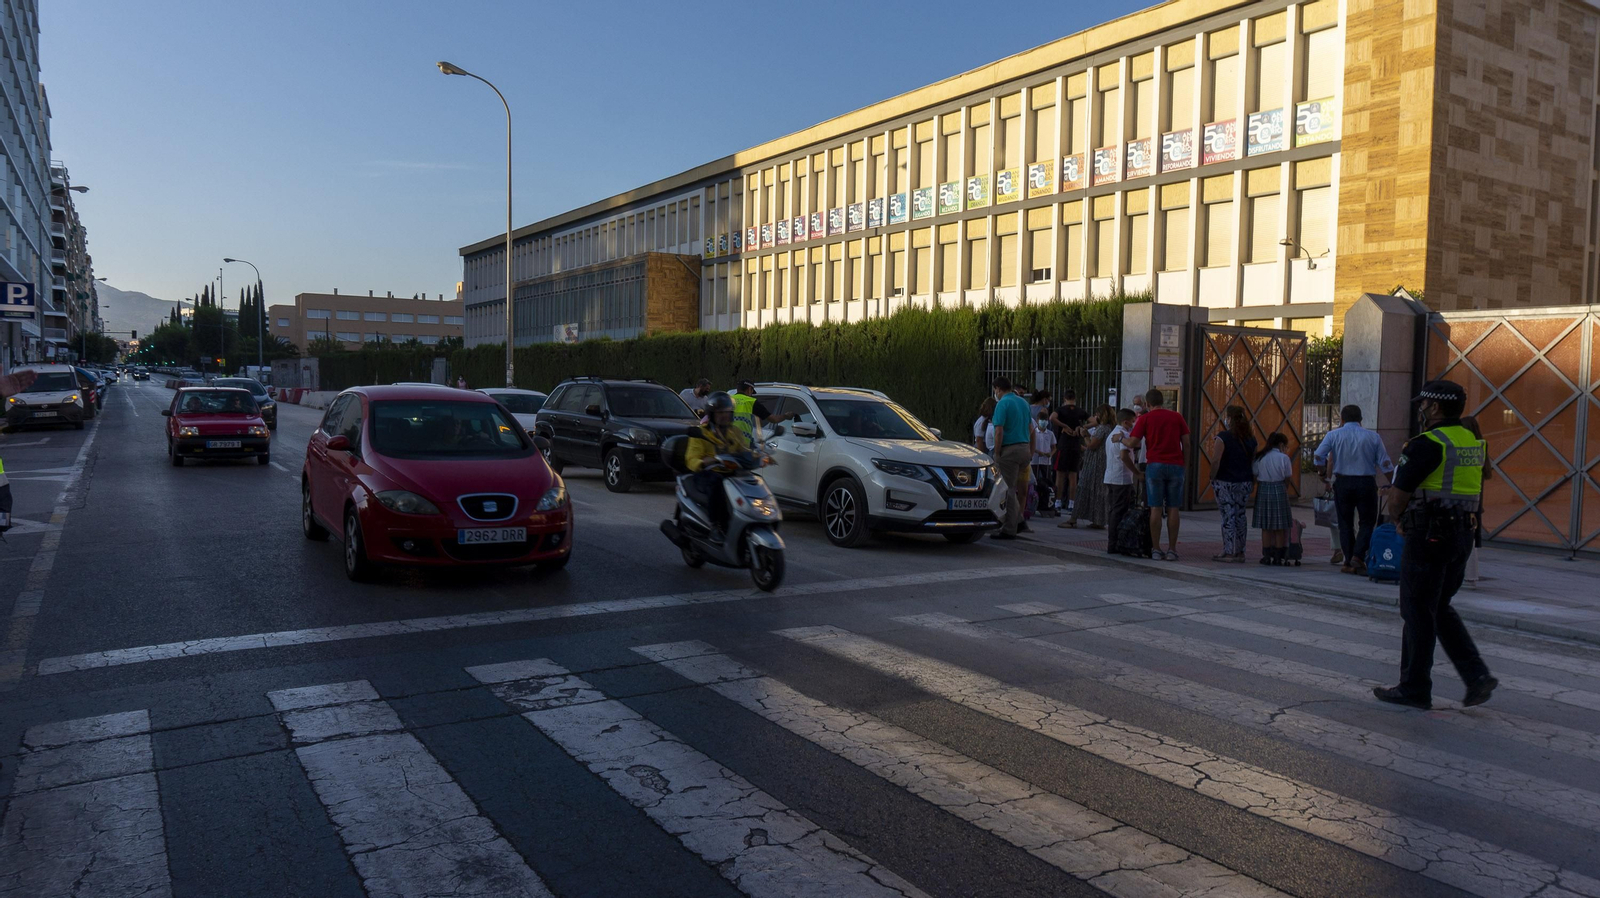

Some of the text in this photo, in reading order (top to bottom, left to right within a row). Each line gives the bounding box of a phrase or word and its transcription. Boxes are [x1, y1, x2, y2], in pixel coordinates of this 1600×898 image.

[1298, 132, 1332, 144] ESTANDO
[1206, 152, 1235, 162] VIVIENDO
[7, 283, 28, 304] P
[954, 500, 987, 508] 4048 KGG
[466, 529, 524, 542] 2962 DRR
